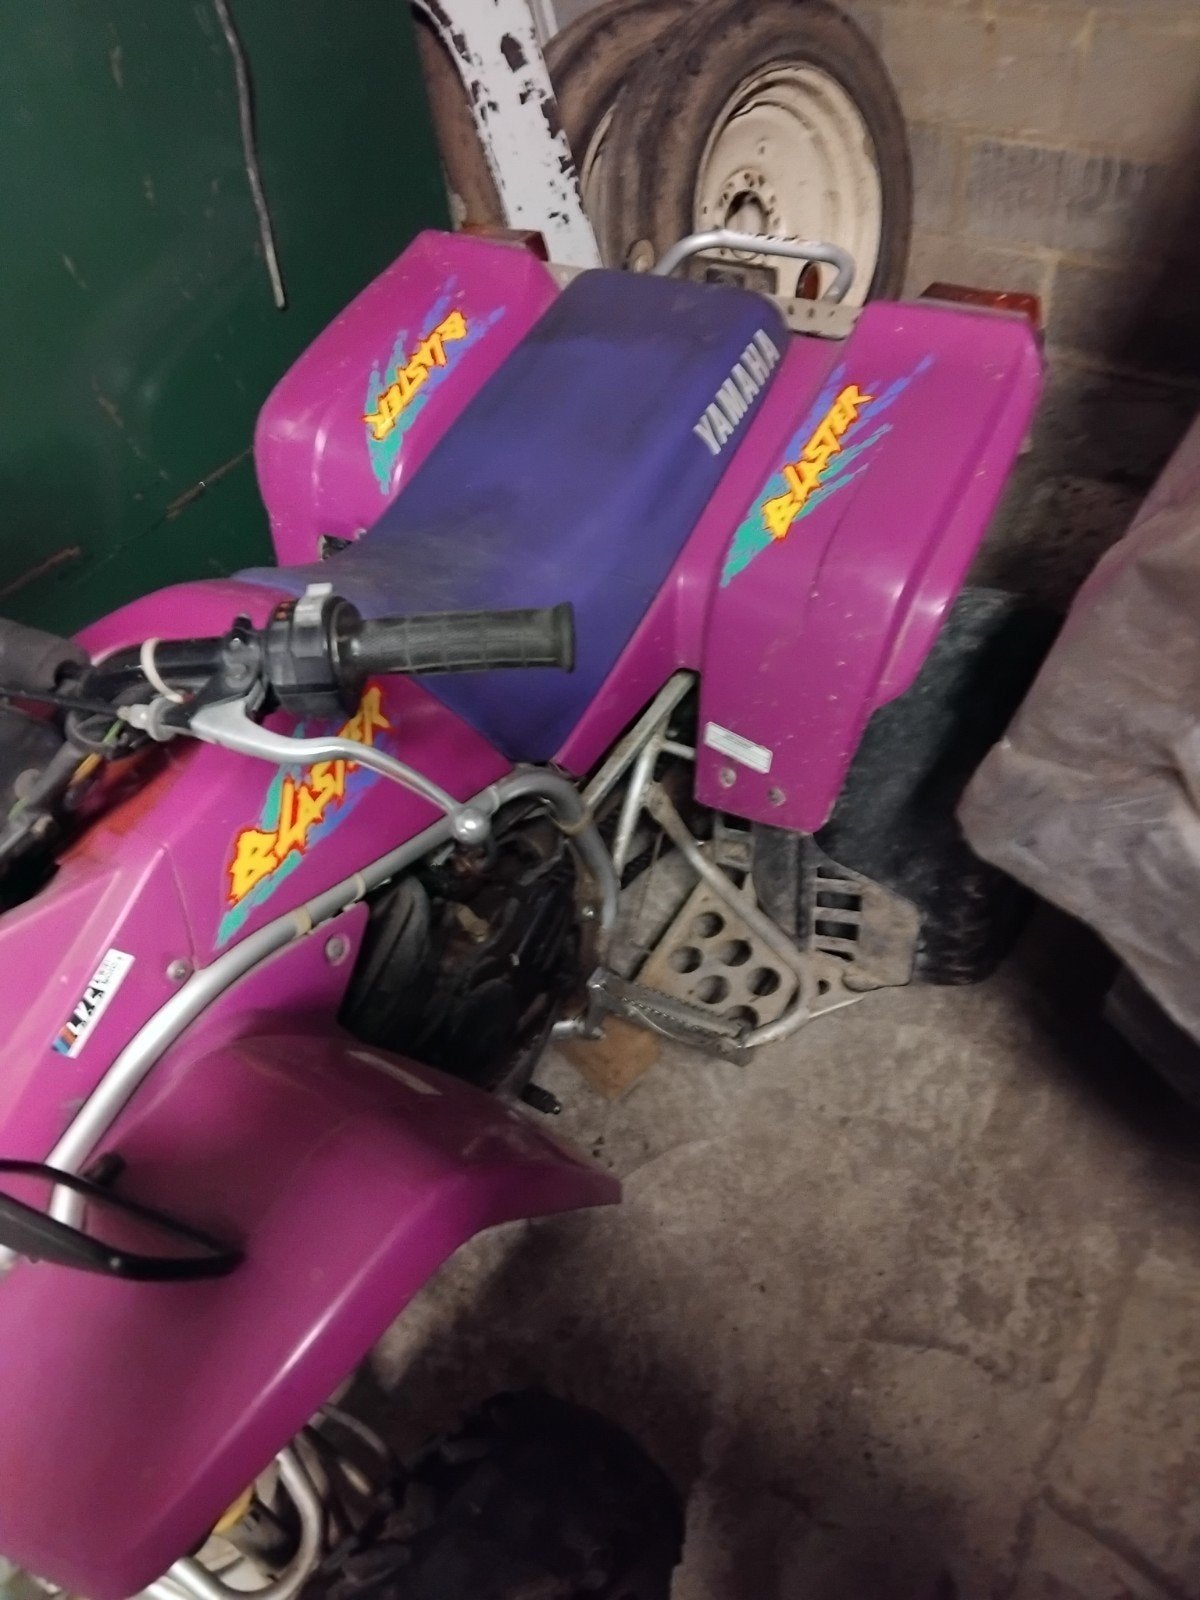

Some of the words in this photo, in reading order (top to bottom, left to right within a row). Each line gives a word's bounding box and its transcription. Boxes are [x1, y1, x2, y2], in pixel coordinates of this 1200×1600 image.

[361, 309, 467, 441] BLASTER
[693, 328, 781, 456] YAMAHA
[760, 384, 875, 541] BLASTER
